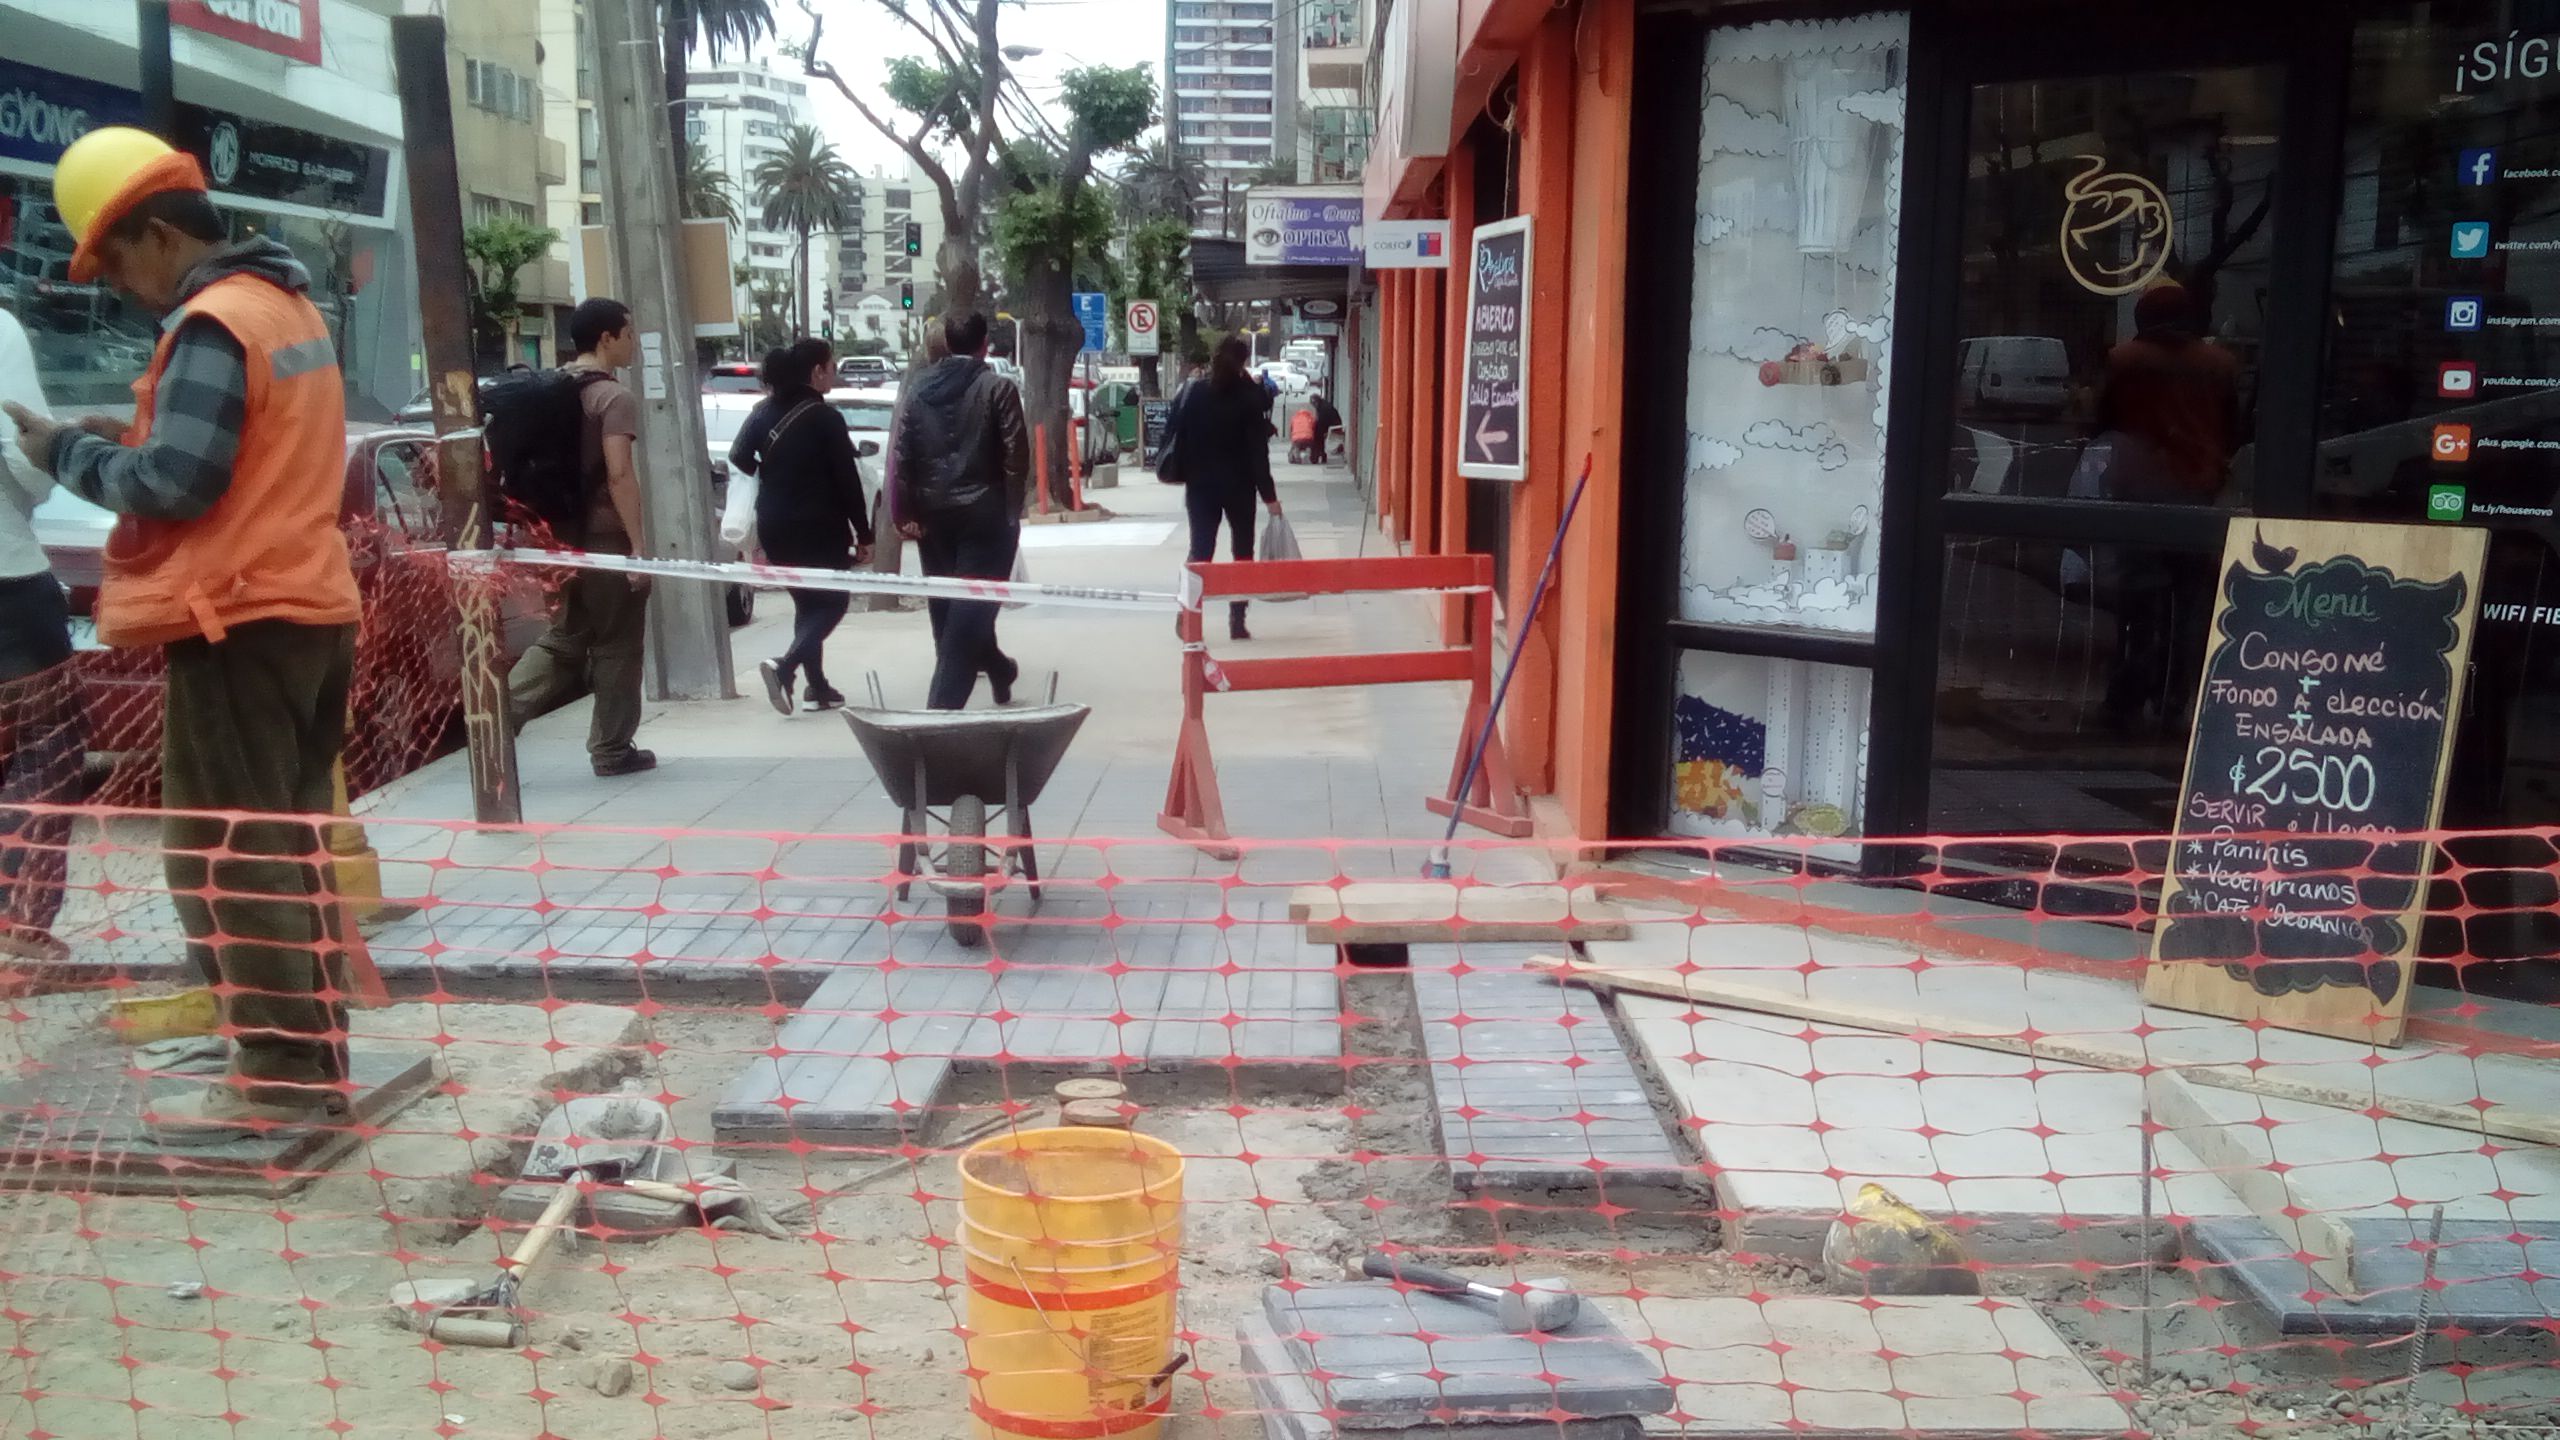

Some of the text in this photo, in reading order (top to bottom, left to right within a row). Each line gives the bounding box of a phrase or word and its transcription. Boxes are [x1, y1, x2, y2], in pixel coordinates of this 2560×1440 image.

[2483, 603, 2527, 623] WIFI
[2235, 713, 2373, 750] ENSALADA
[2189, 792, 2267, 828] SERVIR
